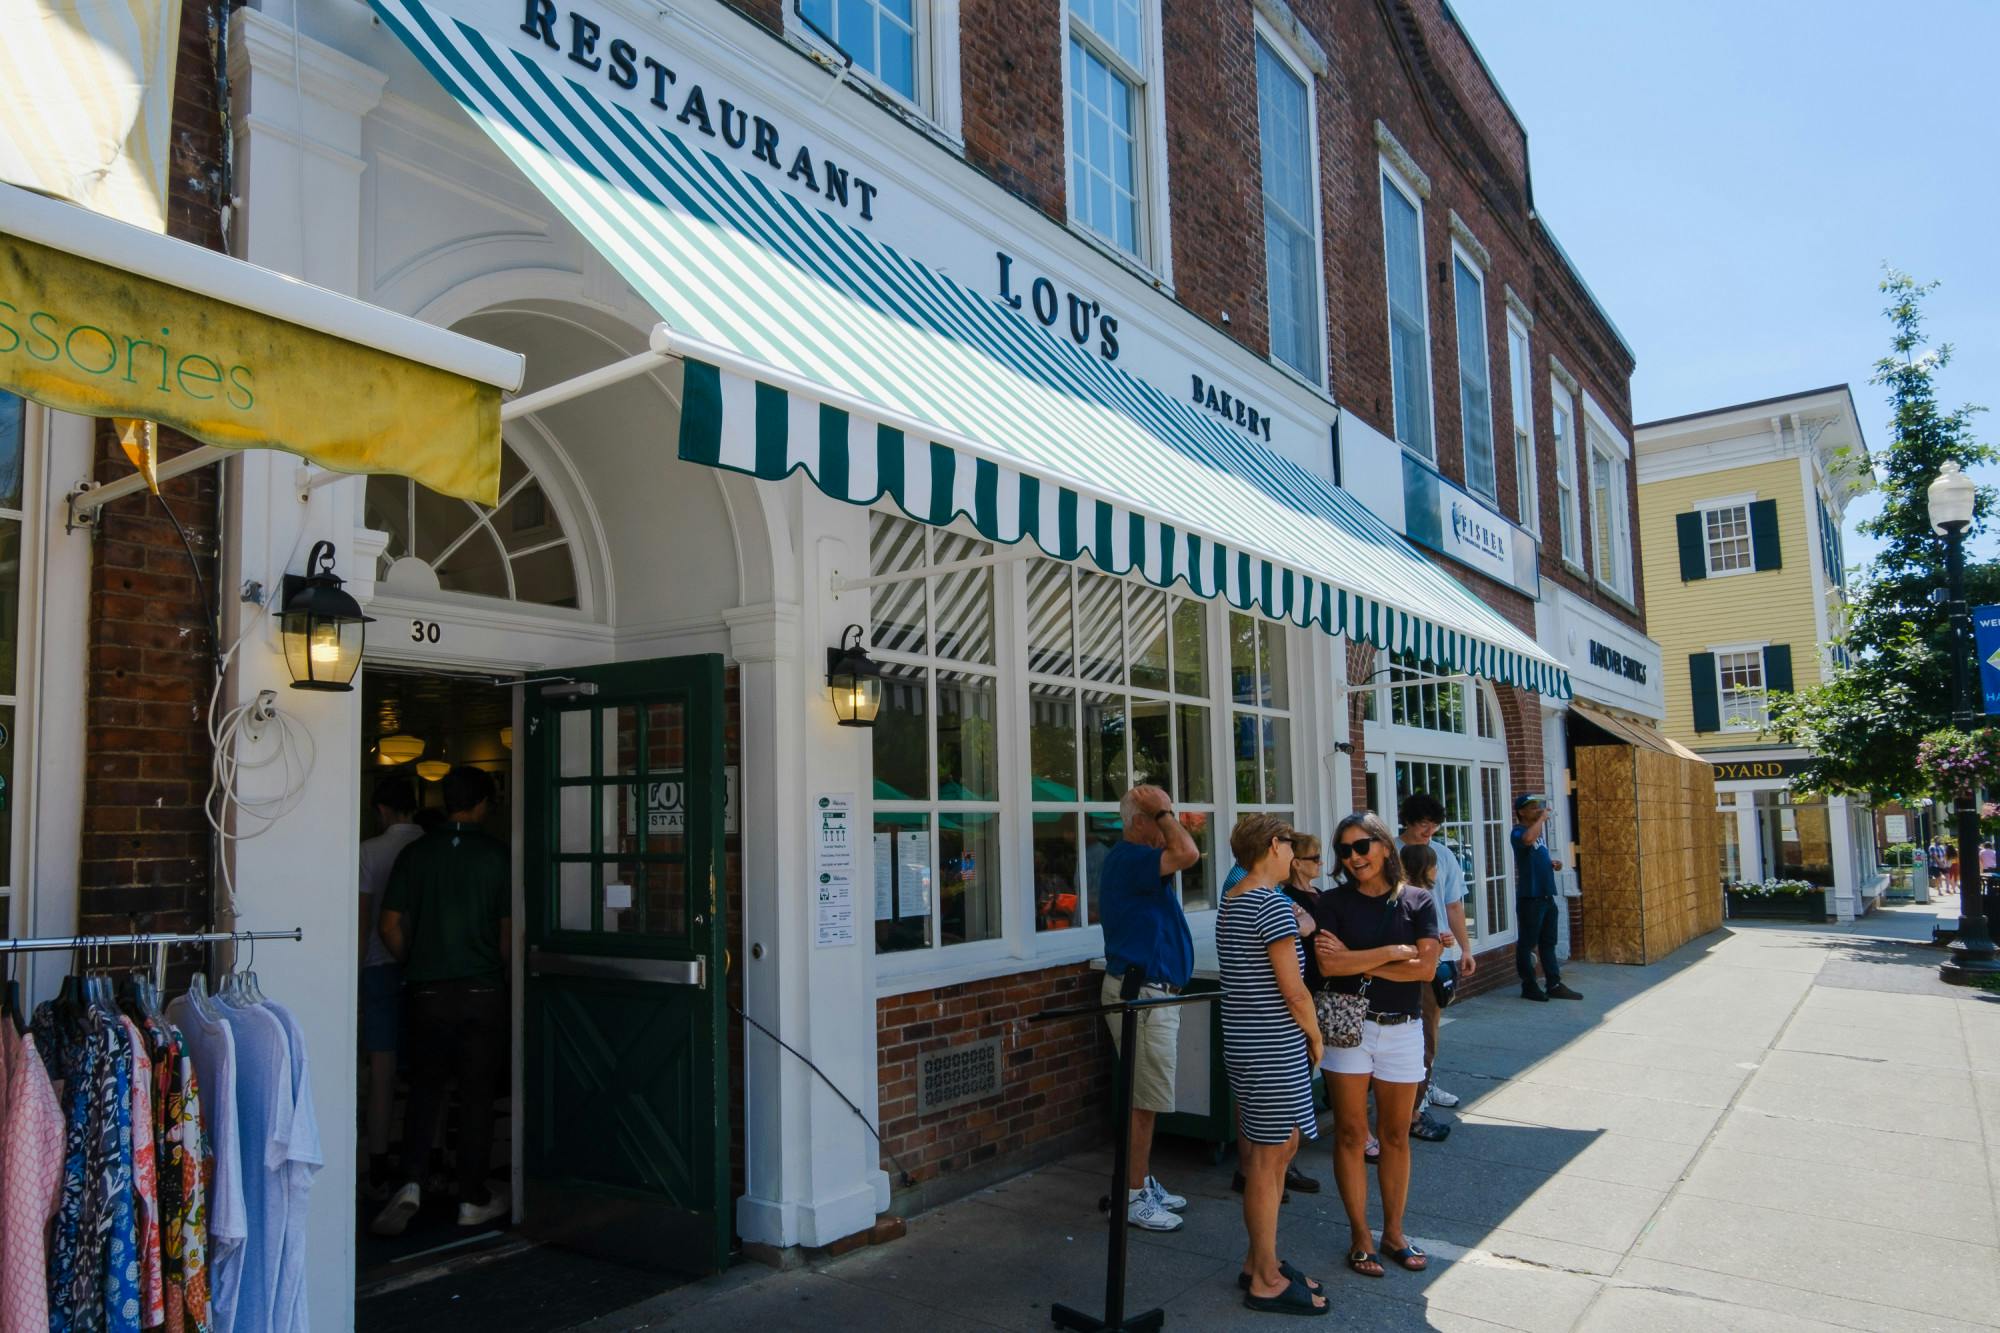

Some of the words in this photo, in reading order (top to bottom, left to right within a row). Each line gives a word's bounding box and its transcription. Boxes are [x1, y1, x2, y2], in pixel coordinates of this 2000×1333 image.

[520, 0, 878, 221] RESTAURANT
[996, 252, 1120, 361] LOU'S
[1192, 374, 1271, 442] BAKERY
[1461, 514, 1504, 555] FISHER
[412, 620, 441, 643] 30
